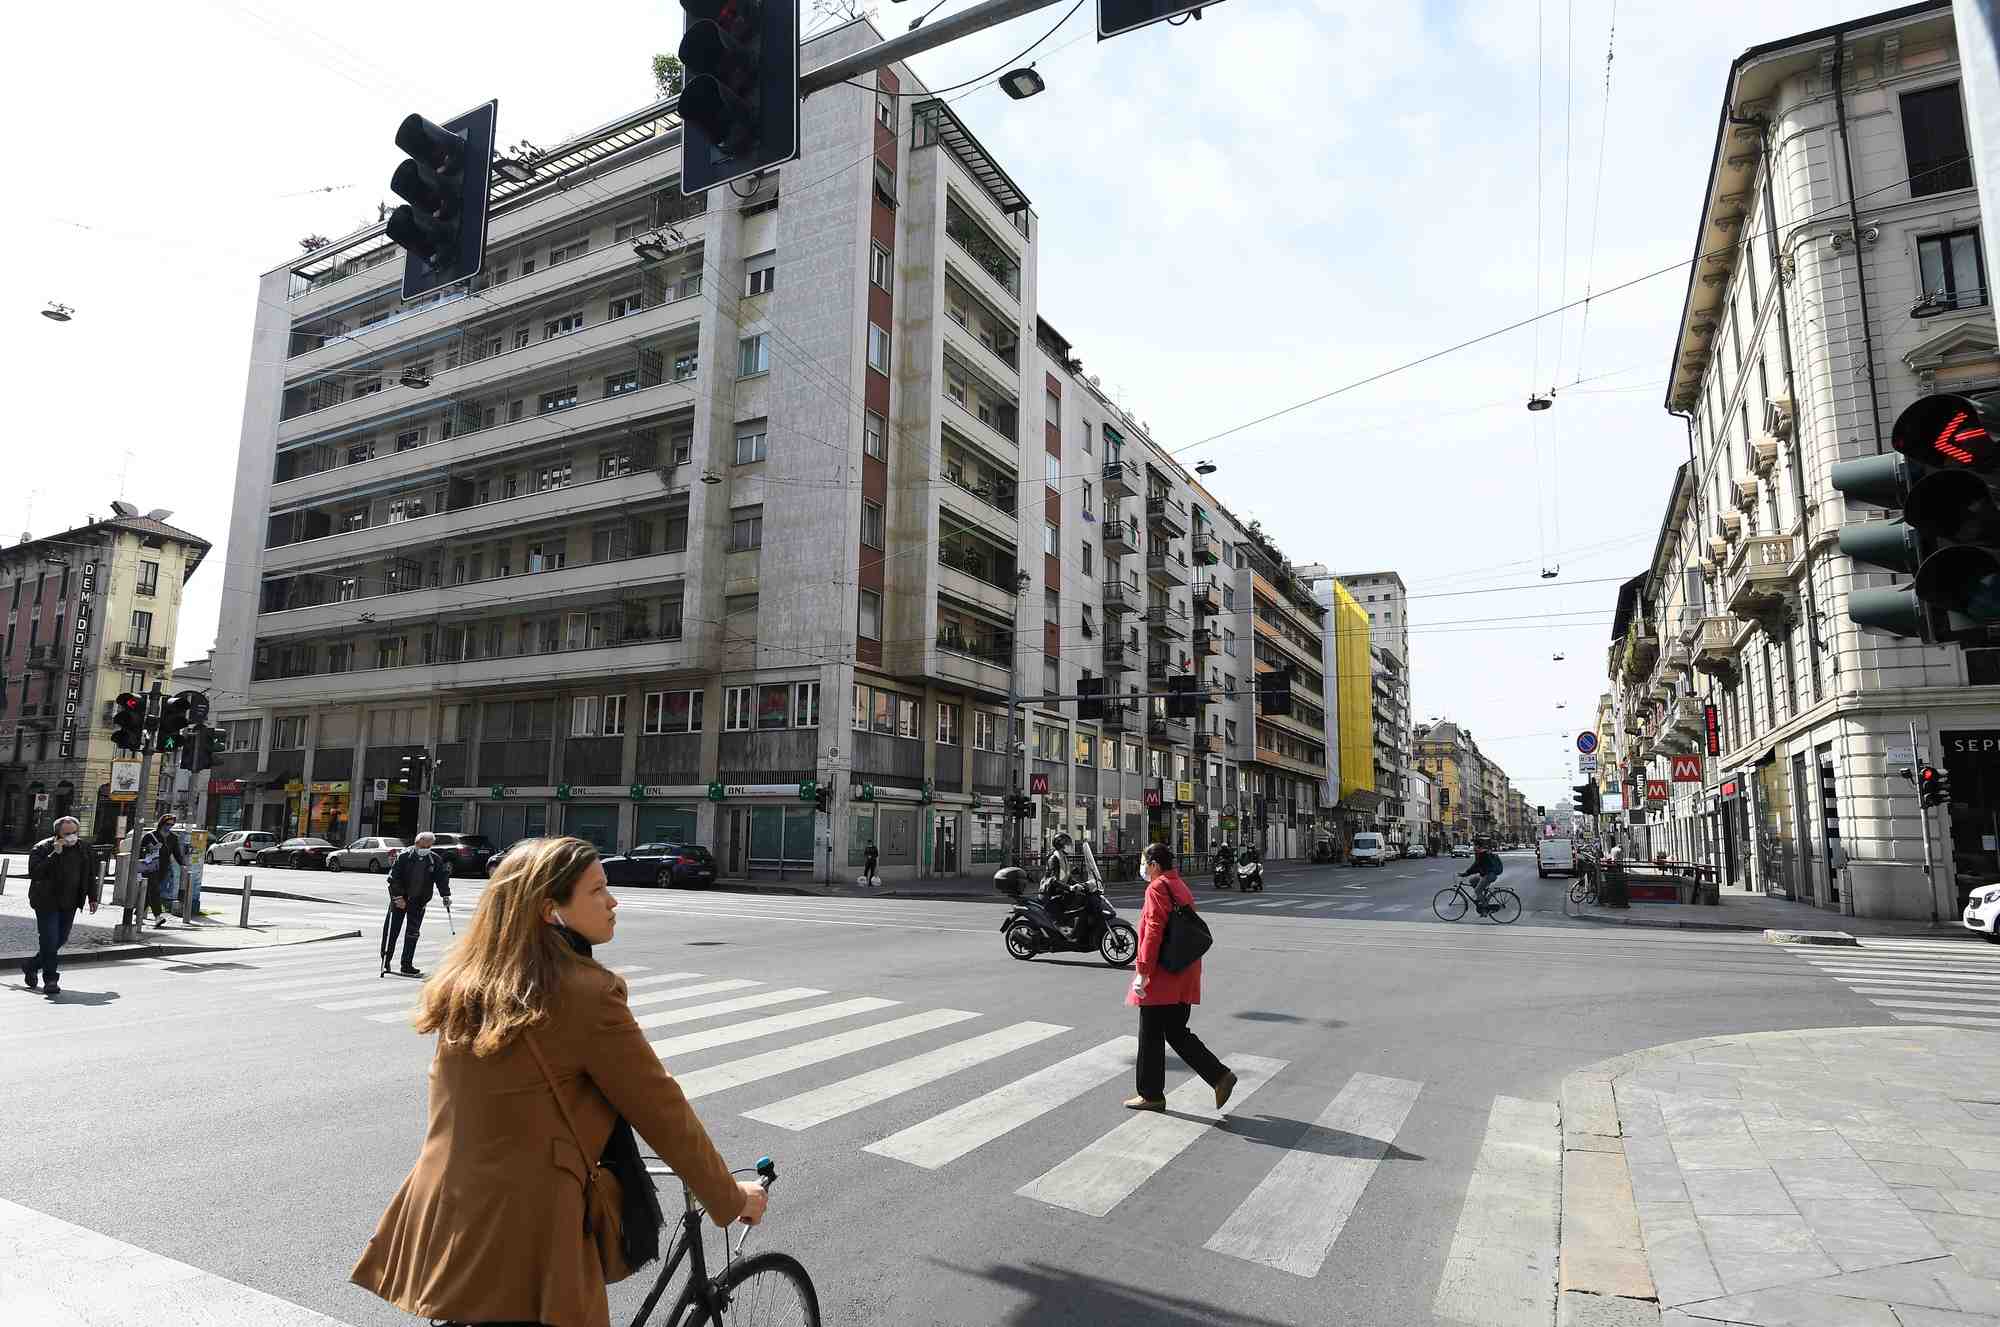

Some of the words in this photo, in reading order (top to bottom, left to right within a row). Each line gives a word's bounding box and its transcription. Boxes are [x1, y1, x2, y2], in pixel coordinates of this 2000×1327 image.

[73, 564, 94, 671] DEMIDOFF
[61, 688, 78, 756] HOTEL
[1955, 739, 2000, 752] SEP
